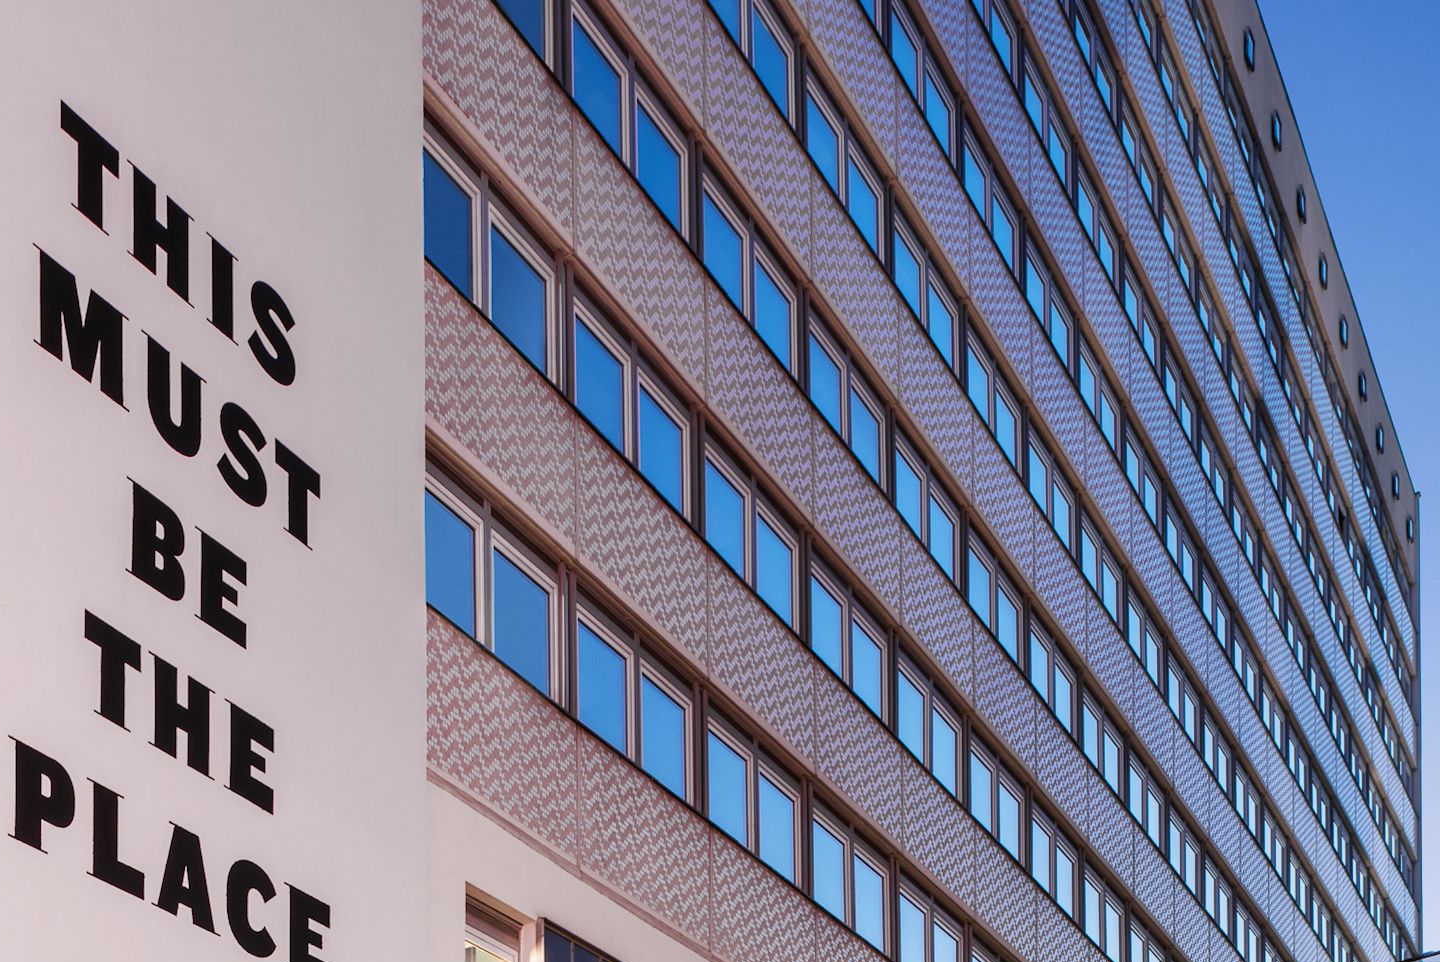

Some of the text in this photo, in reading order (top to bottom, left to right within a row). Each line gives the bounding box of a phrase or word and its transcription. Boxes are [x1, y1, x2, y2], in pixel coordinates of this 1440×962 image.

[60, 99, 296, 387] THIS
[32, 242, 321, 551] MUST
[125, 475, 247, 650] BE
[84, 608, 275, 816] THE
